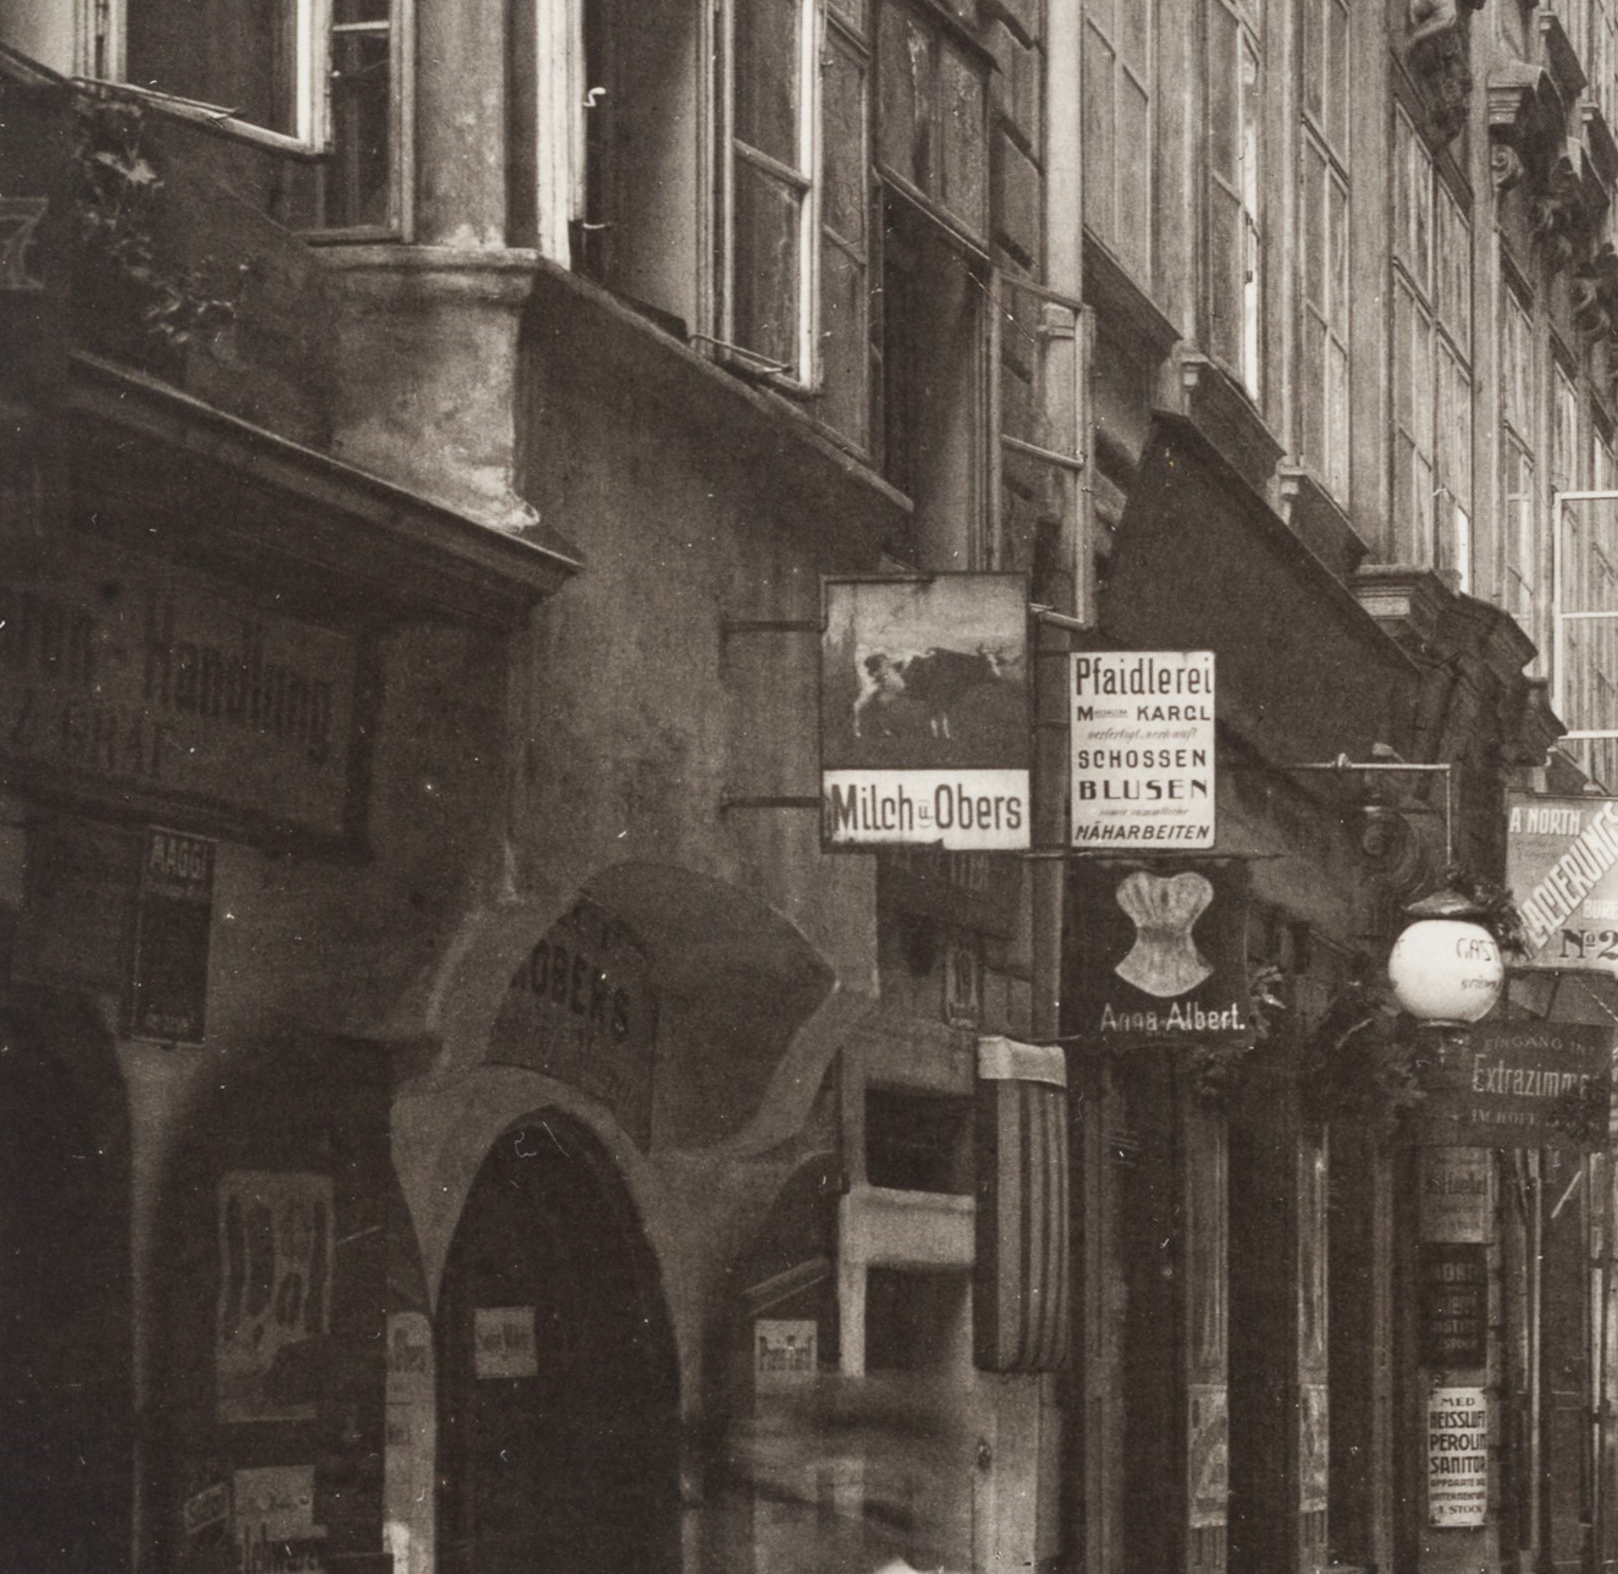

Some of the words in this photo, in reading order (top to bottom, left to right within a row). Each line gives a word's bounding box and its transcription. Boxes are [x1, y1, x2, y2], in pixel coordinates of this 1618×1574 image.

[1075, 656, 1213, 698] Pfaidlerei
[1078, 749, 1207, 770] SCHOSSEN
[1079, 778, 1208, 801] BLUSEN
[830, 783, 913, 832] Milch
[934, 782, 1022, 831] Obers
[1527, 807, 1582, 836] NORTH
[1074, 819, 1211, 841] NÄHARBEITEN
[1100, 1002, 1158, 1032] Anna
